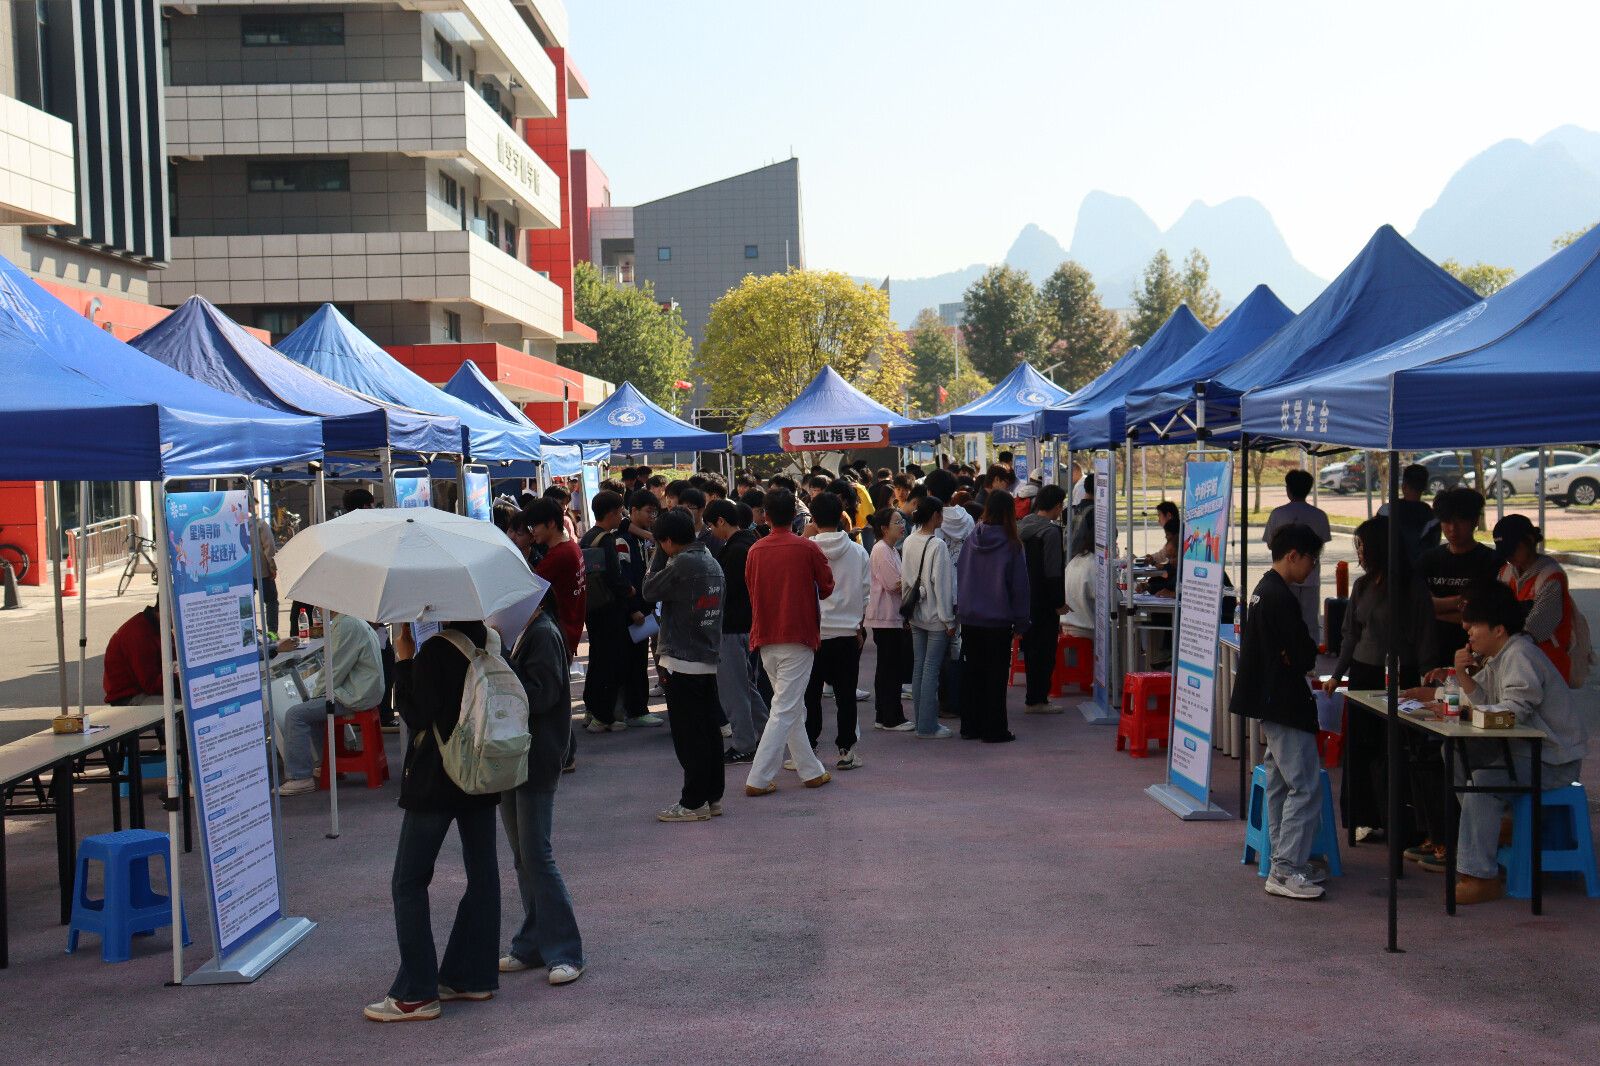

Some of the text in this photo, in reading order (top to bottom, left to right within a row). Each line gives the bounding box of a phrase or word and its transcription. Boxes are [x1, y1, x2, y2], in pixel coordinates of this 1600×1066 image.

[802, 427, 871, 444] 就业指导区
